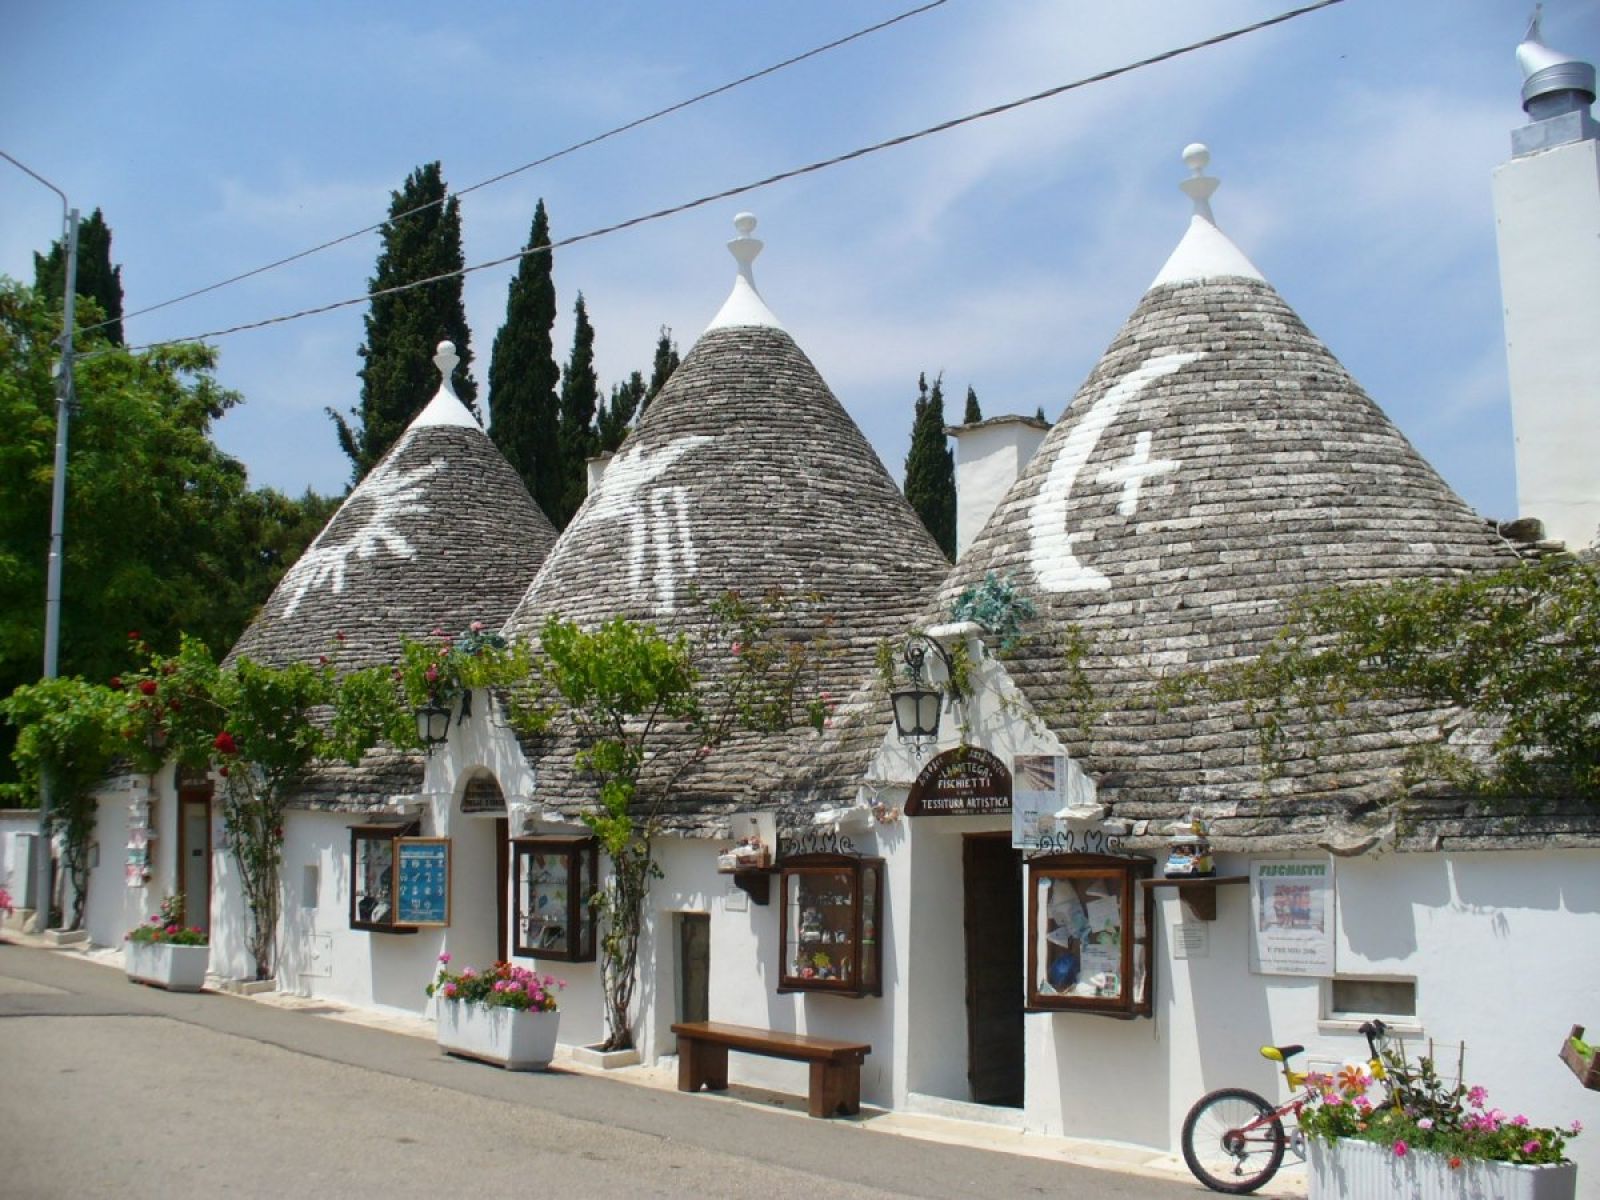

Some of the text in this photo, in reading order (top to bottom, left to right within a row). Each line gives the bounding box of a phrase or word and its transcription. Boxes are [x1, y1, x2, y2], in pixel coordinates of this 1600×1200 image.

[938, 778, 990, 788] FISCHIETTI
[922, 797, 1009, 809] TESSITURA ARTISTICA
